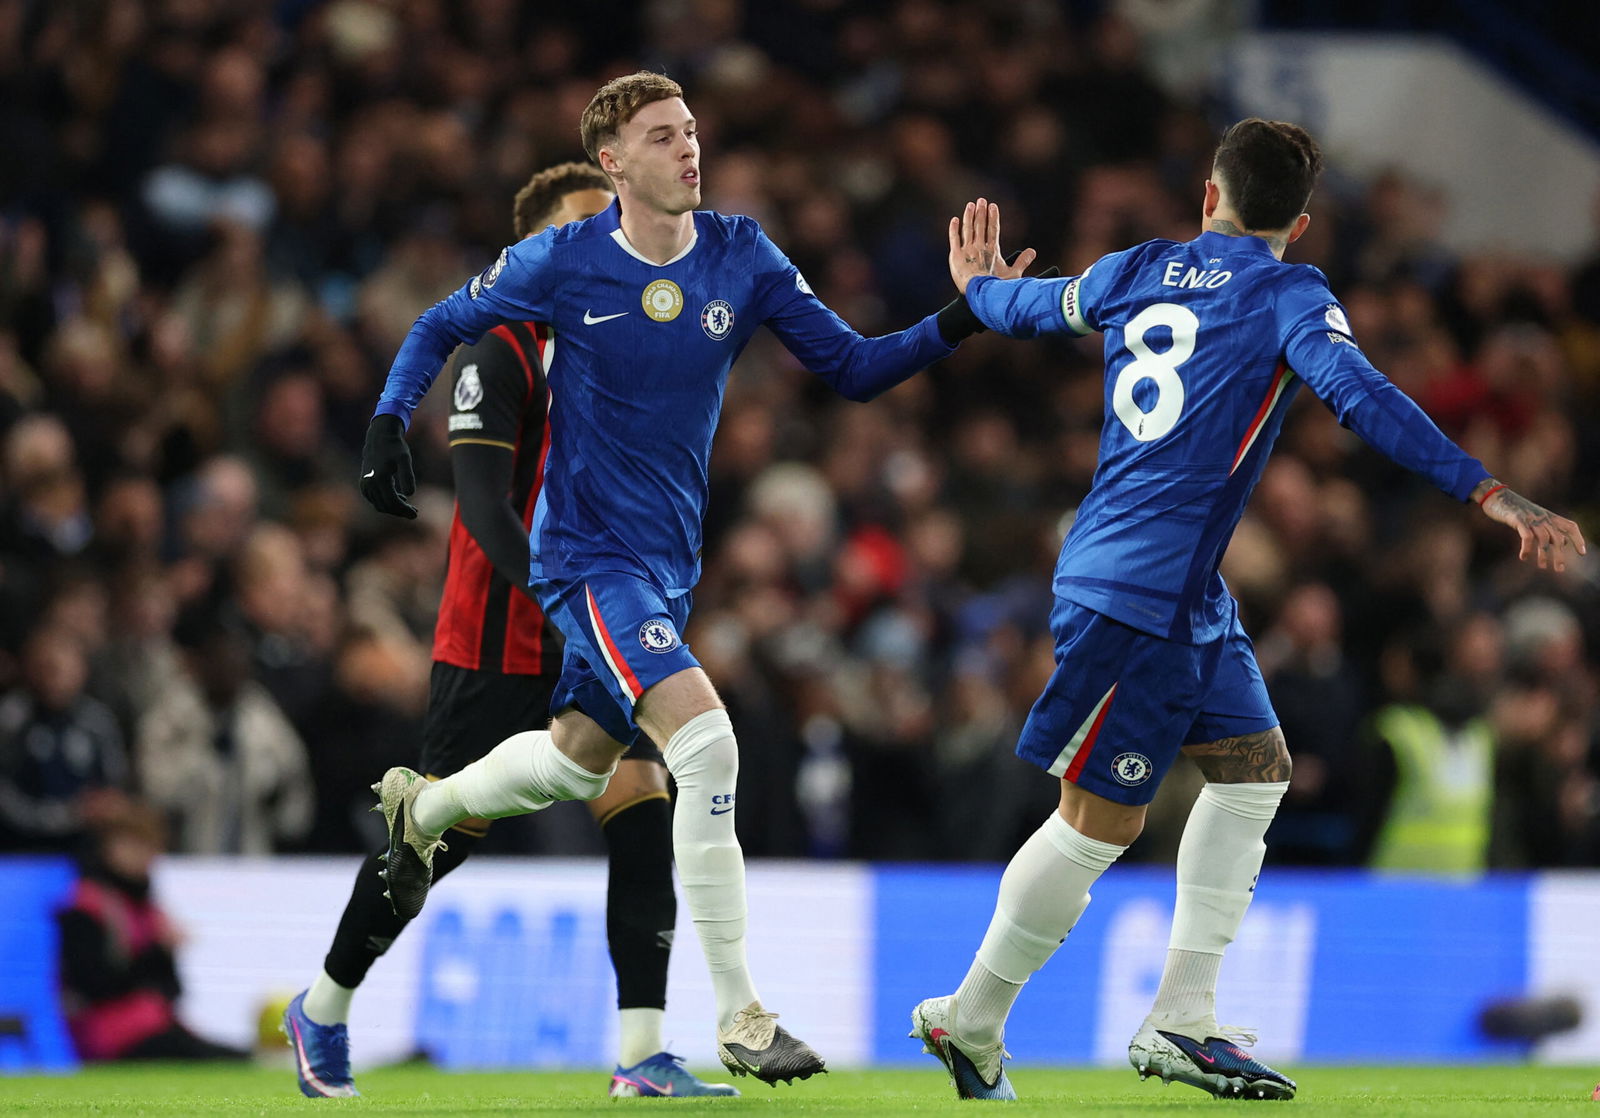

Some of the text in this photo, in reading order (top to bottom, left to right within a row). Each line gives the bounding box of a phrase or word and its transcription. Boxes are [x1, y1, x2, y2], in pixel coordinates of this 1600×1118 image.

[1162, 261, 1233, 289] ENZO
[655, 311, 670, 319] FIFA
[706, 301, 729, 311] CHELSEA
[1112, 302, 1200, 442] 8
